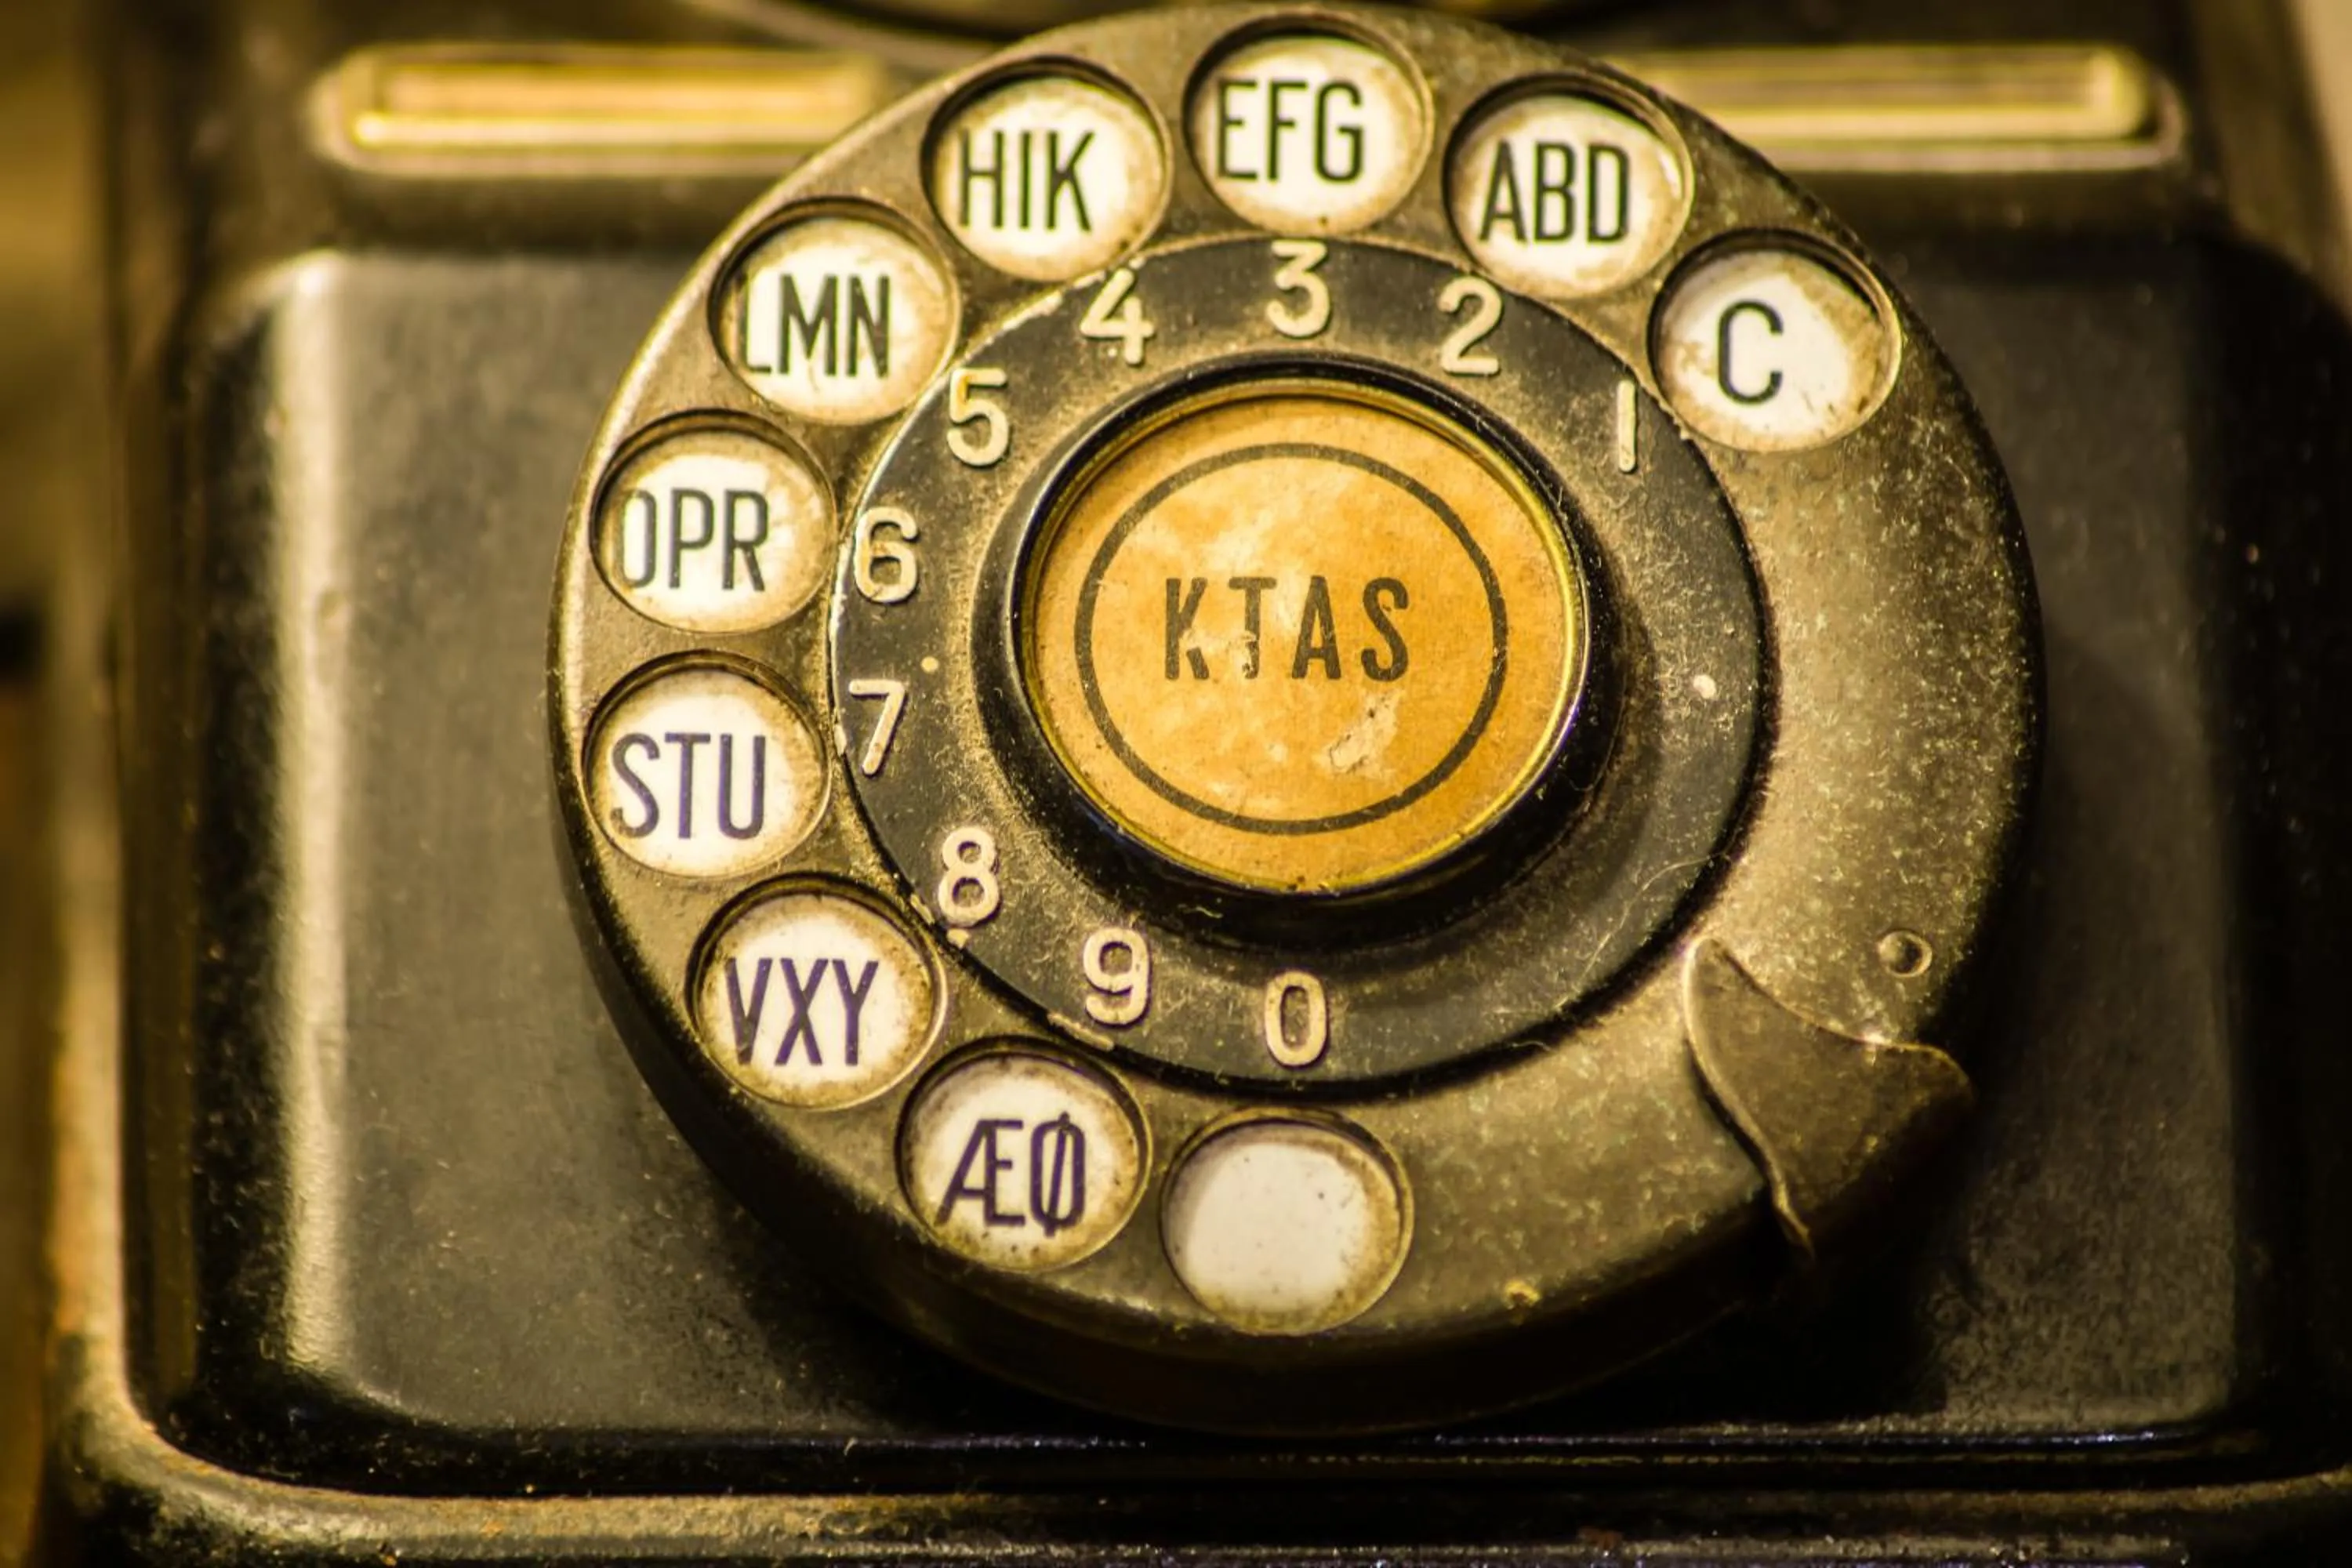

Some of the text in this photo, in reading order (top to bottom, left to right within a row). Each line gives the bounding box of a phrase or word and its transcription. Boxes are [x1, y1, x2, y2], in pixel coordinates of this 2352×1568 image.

[958, 131, 1096, 231] HIK
[1217, 79, 1364, 183] EFG
[1479, 139, 1630, 244] ABD
[736, 274, 891, 378] LMN
[1080, 267, 1155, 365] 4
[1266, 240, 1331, 337] 3
[1438, 277, 1502, 375] 2
[1717, 299, 1784, 405] C
[946, 367, 1011, 466] 5
[1615, 379, 1638, 473] 1
[617, 488, 770, 591] OPR
[854, 506, 919, 604] 6
[1163, 575, 1410, 681] KTAS
[848, 679, 907, 776] 7
[610, 732, 768, 840] STU
[938, 826, 1000, 927] 8
[724, 957, 879, 1066] VXY
[1083, 927, 1151, 1025] 9
[1264, 970, 1328, 1067] 0
[936, 1111, 1086, 1237] ÆØ
